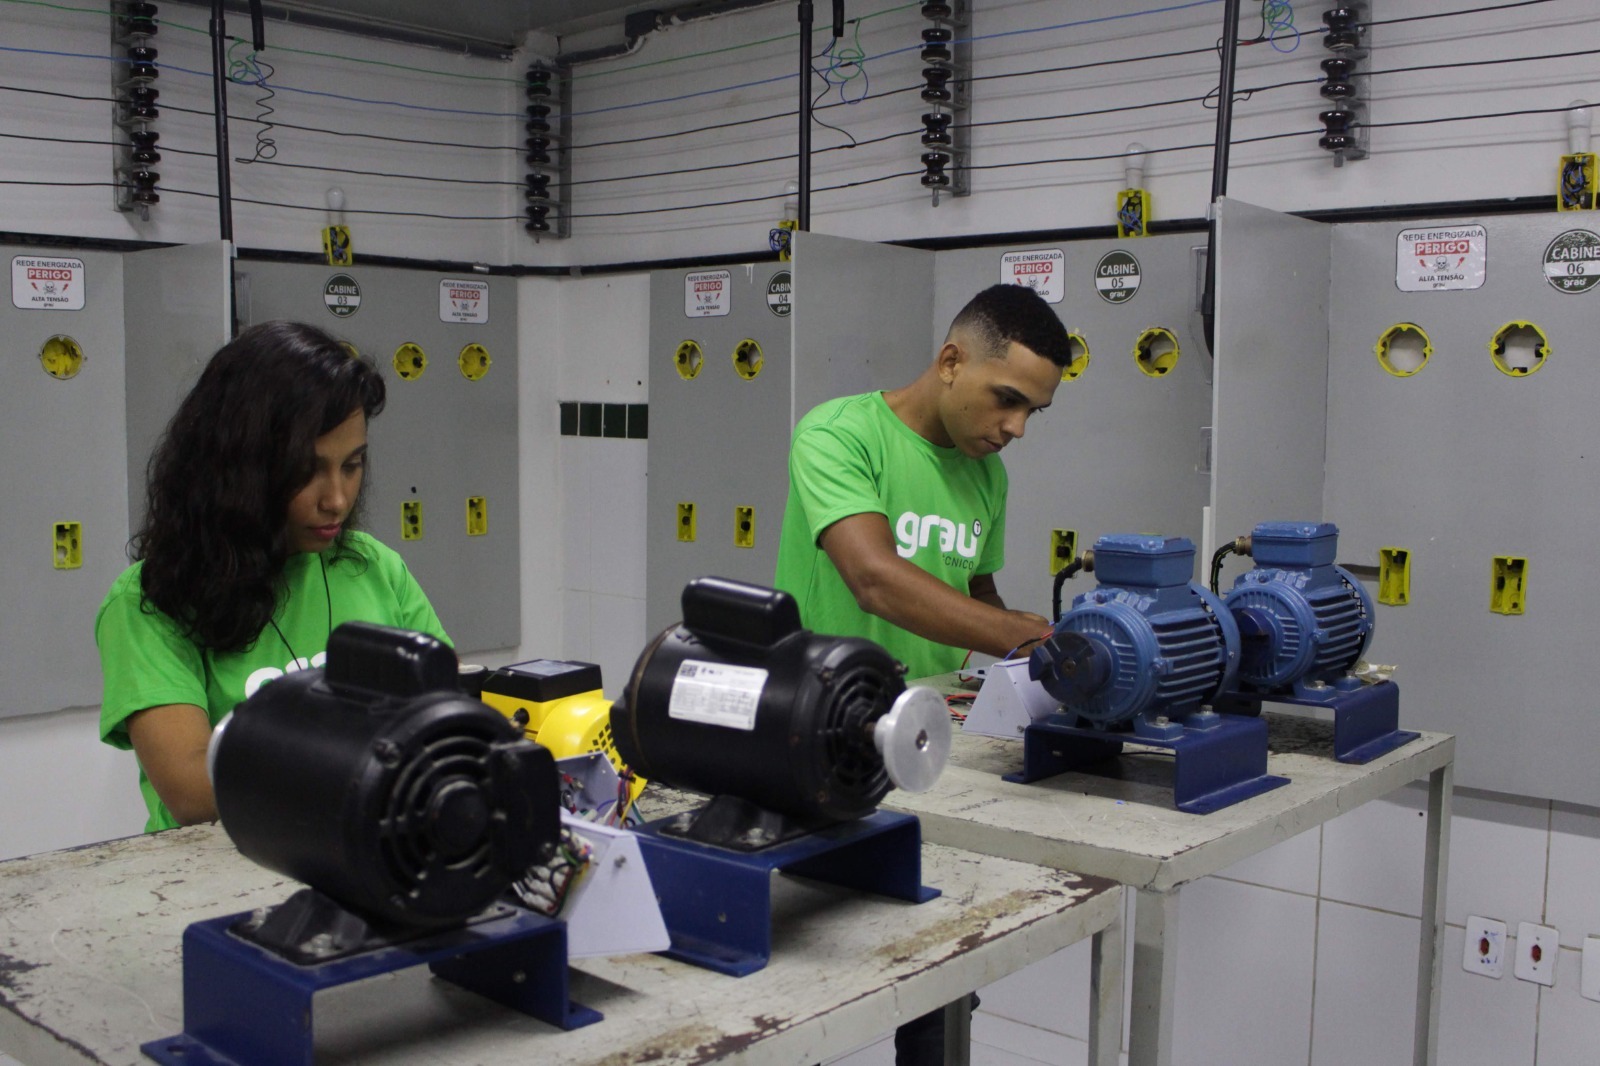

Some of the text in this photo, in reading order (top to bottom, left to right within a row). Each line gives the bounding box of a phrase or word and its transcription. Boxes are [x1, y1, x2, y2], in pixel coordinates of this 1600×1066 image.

[1403, 230, 1484, 241] REDE ENERGIZADA
[1416, 241, 1468, 254] PERIGO
[1552, 245, 1600, 260] CABINE
[1022, 253, 1063, 262] ENERGIZADA
[37, 261, 82, 269] ENERGIZADA
[1014, 263, 1052, 274] PERIGO
[1100, 263, 1136, 276] CABINE
[1567, 262, 1584, 275] 06
[28, 269, 71, 280] PERIGO
[695, 282, 722, 292] PERIGO
[770, 282, 791, 293] CABIN
[1111, 277, 1124, 289] 05
[328, 284, 357, 295] CABINE
[450, 290, 480, 299] PERIGO
[337, 296, 348, 305] 03
[778, 294, 788, 304] 04
[895, 511, 978, 558] grau
